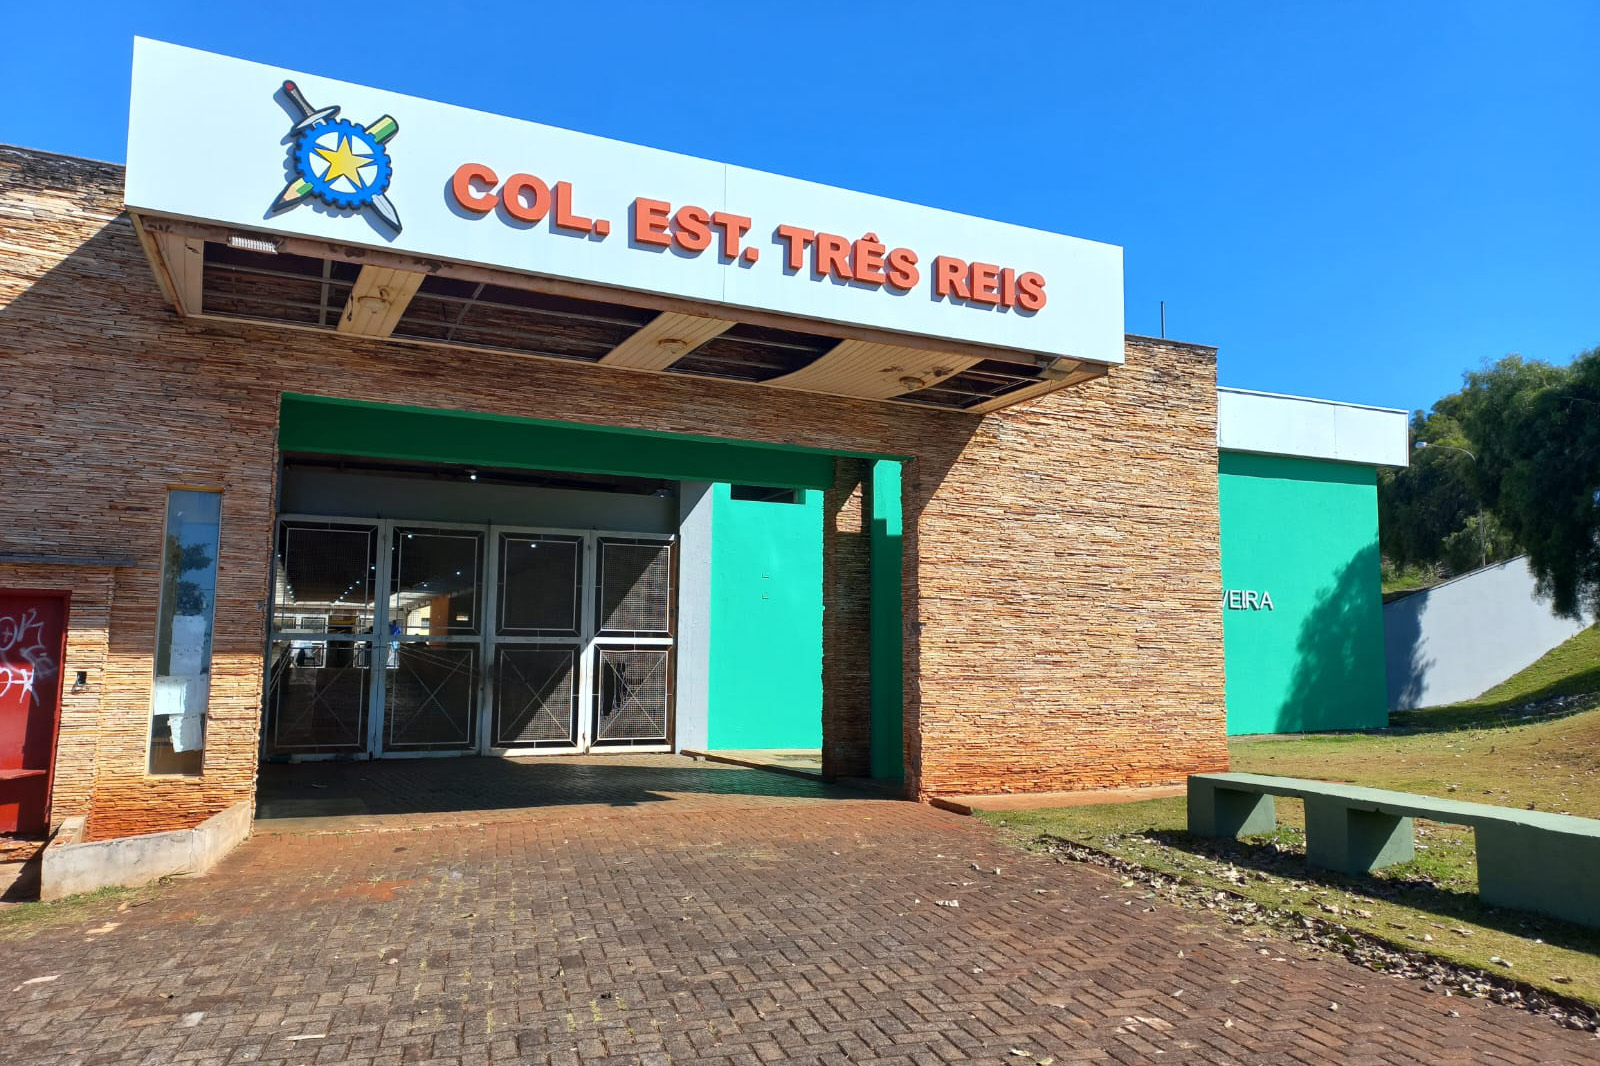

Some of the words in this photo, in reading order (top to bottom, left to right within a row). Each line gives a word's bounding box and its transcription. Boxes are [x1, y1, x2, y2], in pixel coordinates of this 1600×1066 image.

[452, 163, 610, 237] COL.
[635, 196, 759, 262] EST.
[778, 223, 920, 290] TRÊS
[936, 255, 1047, 312] REIS
